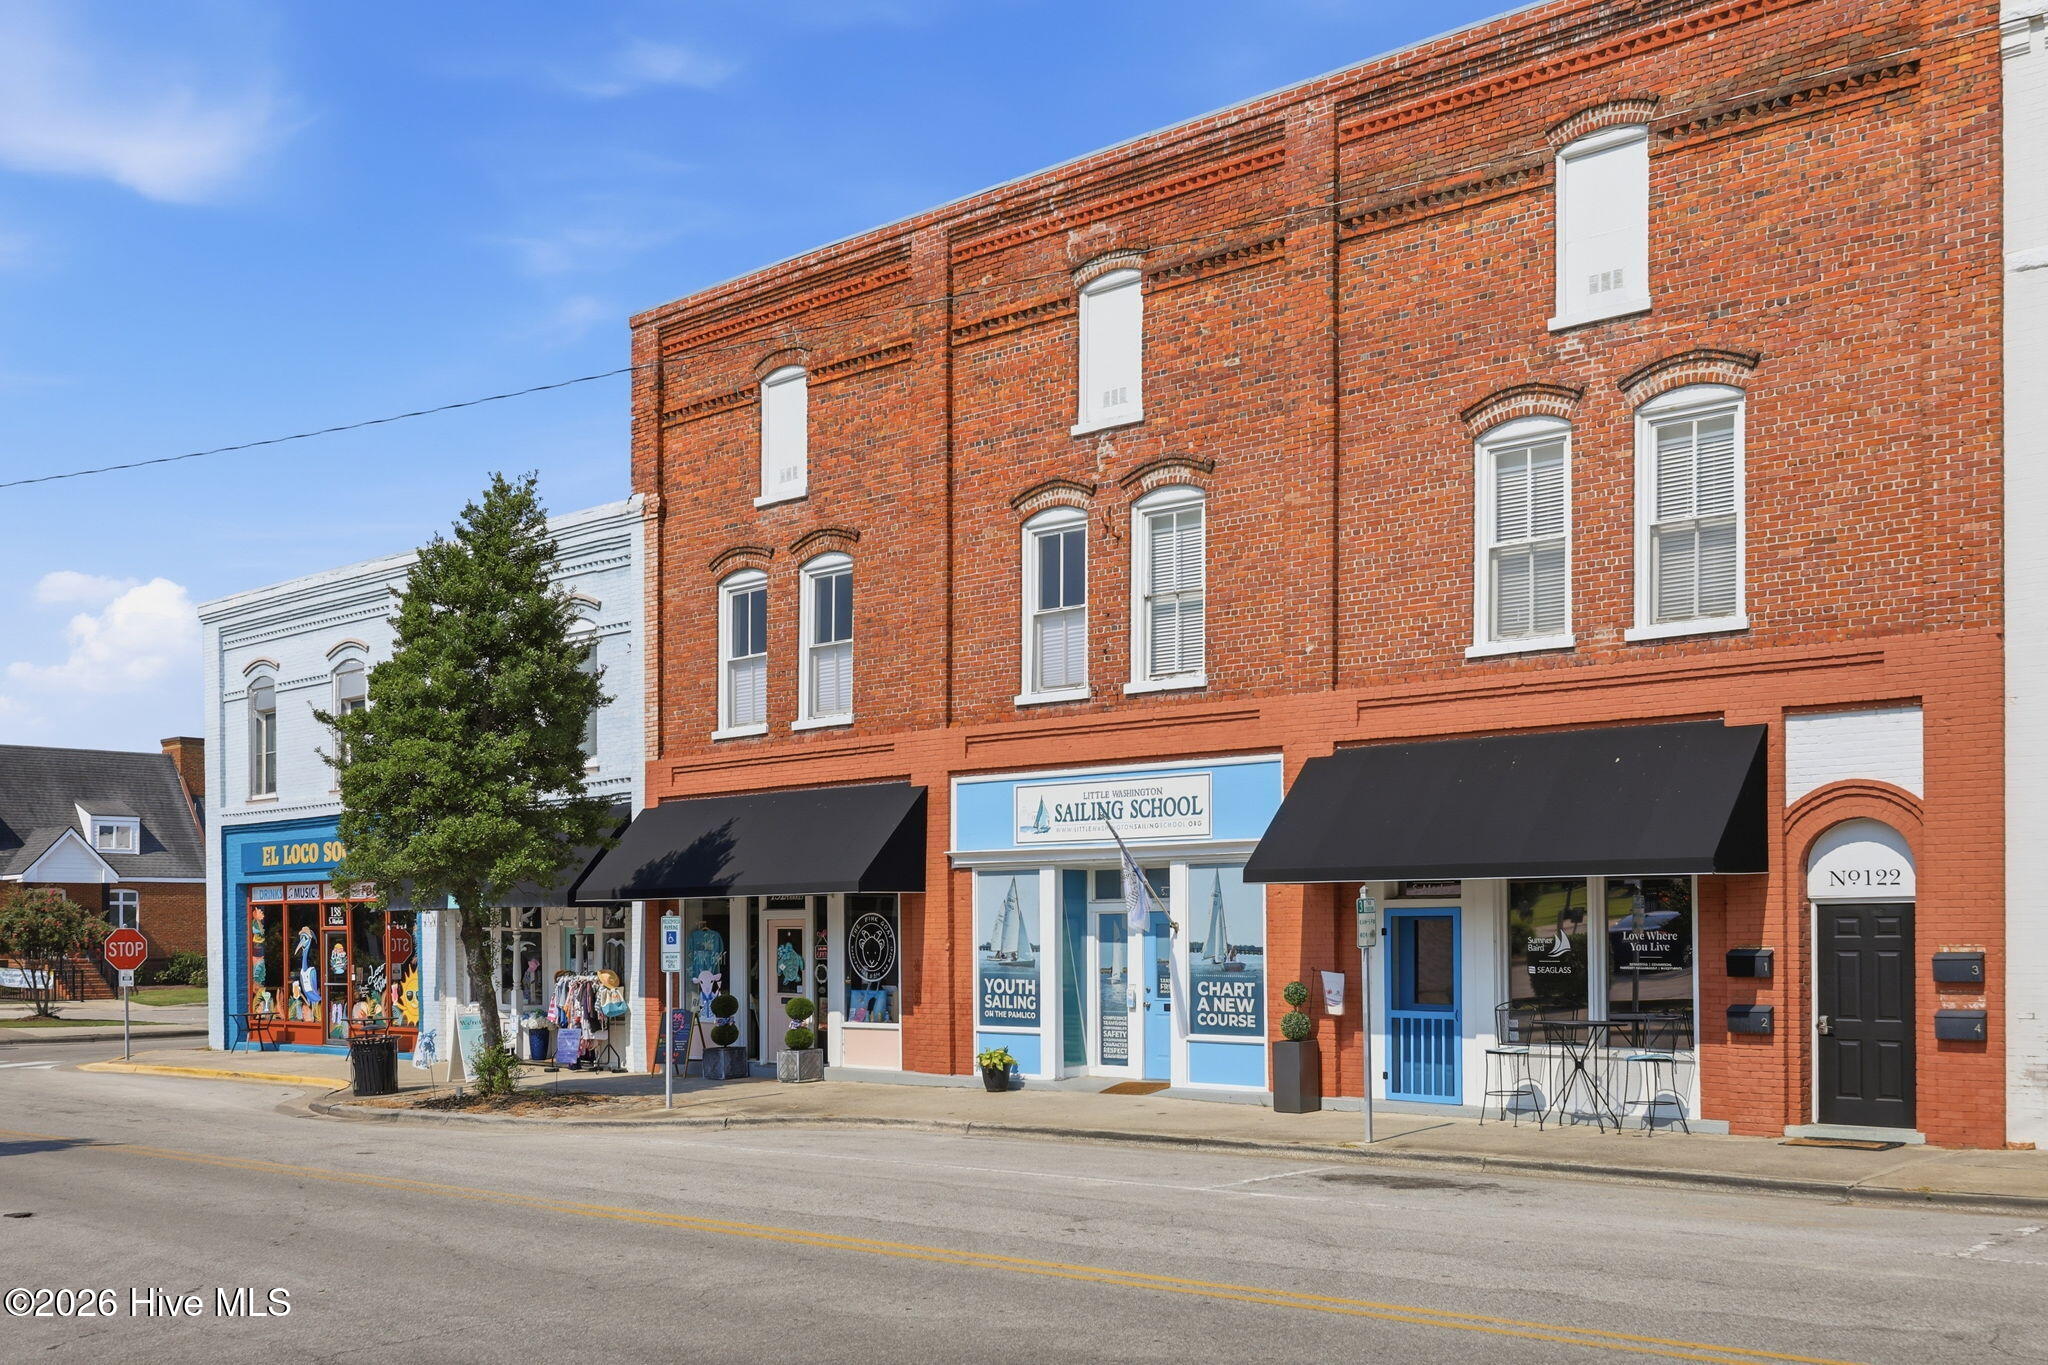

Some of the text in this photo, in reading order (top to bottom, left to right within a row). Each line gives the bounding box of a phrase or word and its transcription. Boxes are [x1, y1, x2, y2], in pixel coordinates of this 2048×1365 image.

[1083, 787, 1163, 800] LITTLE WASHINGTON
[1054, 795, 1203, 823] SAILING SCHOOL
[262, 846, 279, 867] EL
[283, 843, 319, 865] LOCO
[260, 887, 283, 899] DRINKS
[293, 887, 316, 899] MUSIC
[1527, 936, 1553, 944] Sumner
[1622, 931, 1678, 941] Love Where
[108, 941, 144, 957] STOP
[1527, 944, 1545, 952] Baird
[1629, 942, 1670, 952] You Live
[1537, 966, 1572, 974] SEAGLASS
[1763, 962, 1768, 972] 1
[1972, 965, 1980, 976] 3
[984, 977, 1036, 995] YOUTH
[1197, 981, 1256, 997] CHART
[984, 994, 1037, 1010] SAILING
[1197, 997, 1255, 1013] A NEW
[984, 1010, 1036, 1019] ON THE PAMLICO
[1197, 1012, 1256, 1028] COURSE
[1760, 1017, 1768, 1028] 2
[1974, 1023, 1981, 1033] 4
[1103, 1030, 1127, 1038] SAFETY
